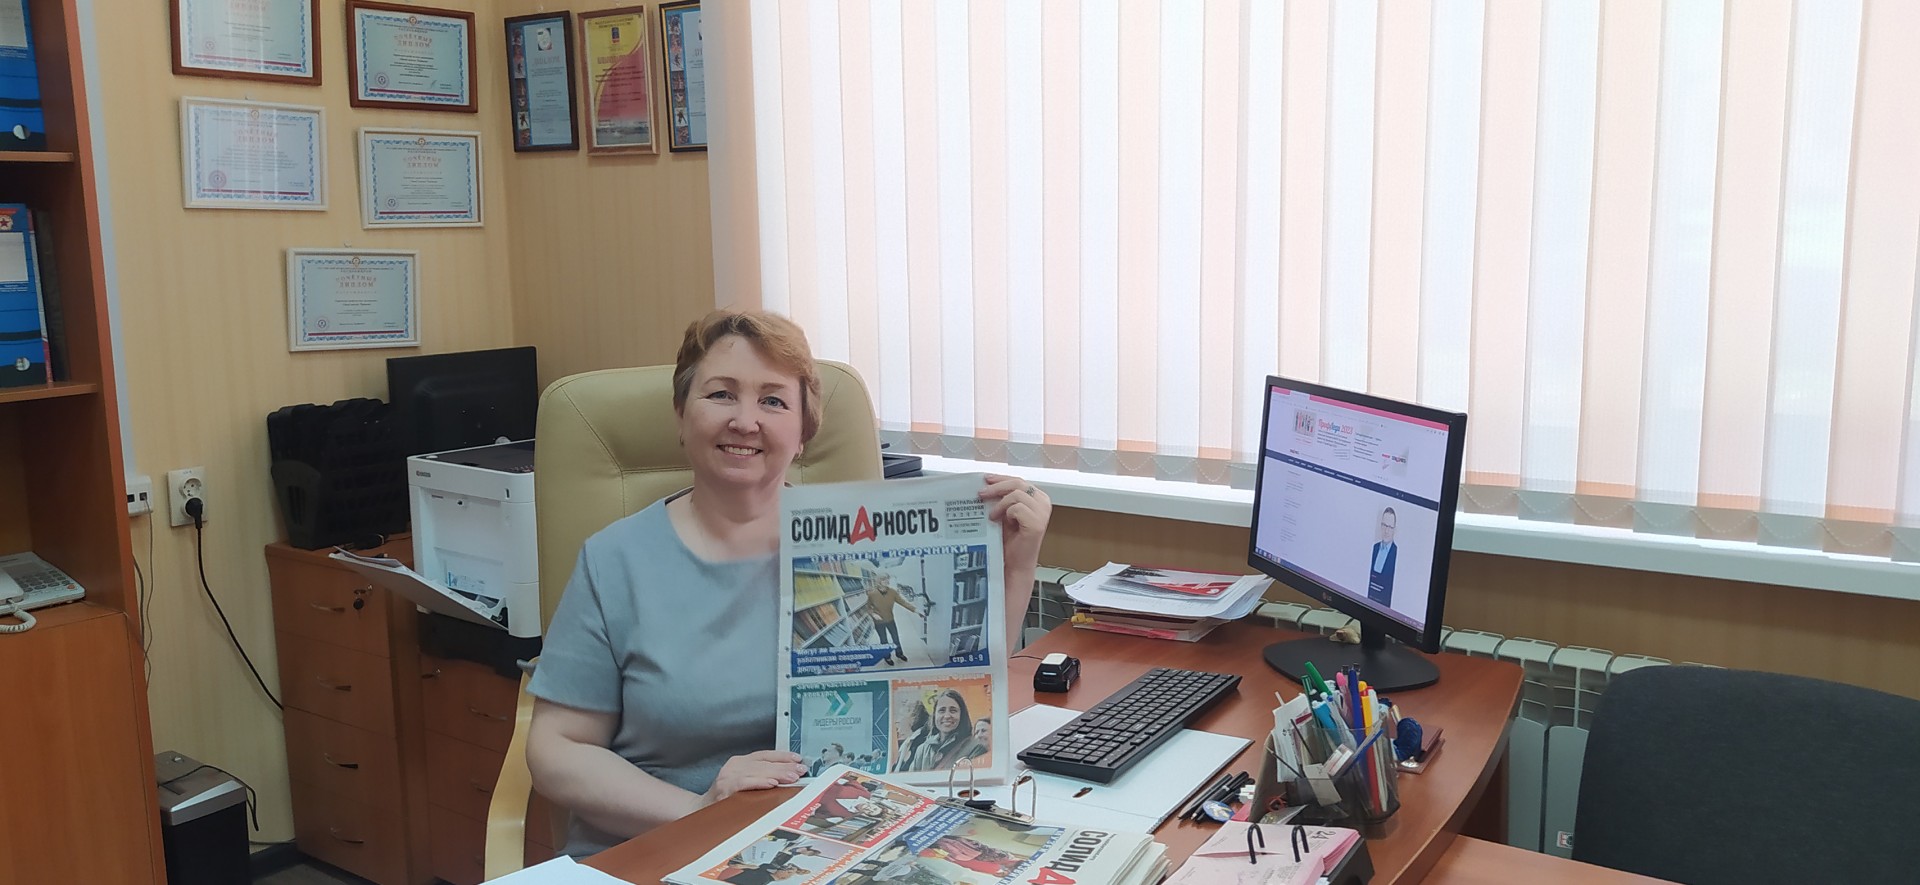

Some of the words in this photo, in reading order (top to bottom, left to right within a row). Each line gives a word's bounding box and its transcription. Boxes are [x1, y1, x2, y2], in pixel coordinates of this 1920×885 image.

[791, 505, 939, 545] СОЛИДАРНОСТЬ
[811, 550, 884, 563] ОТКРЫТЫЕ
[889, 544, 968, 558] ИСТОЧНИКИ
[1027, 830, 1109, 885] СОЛИДА
